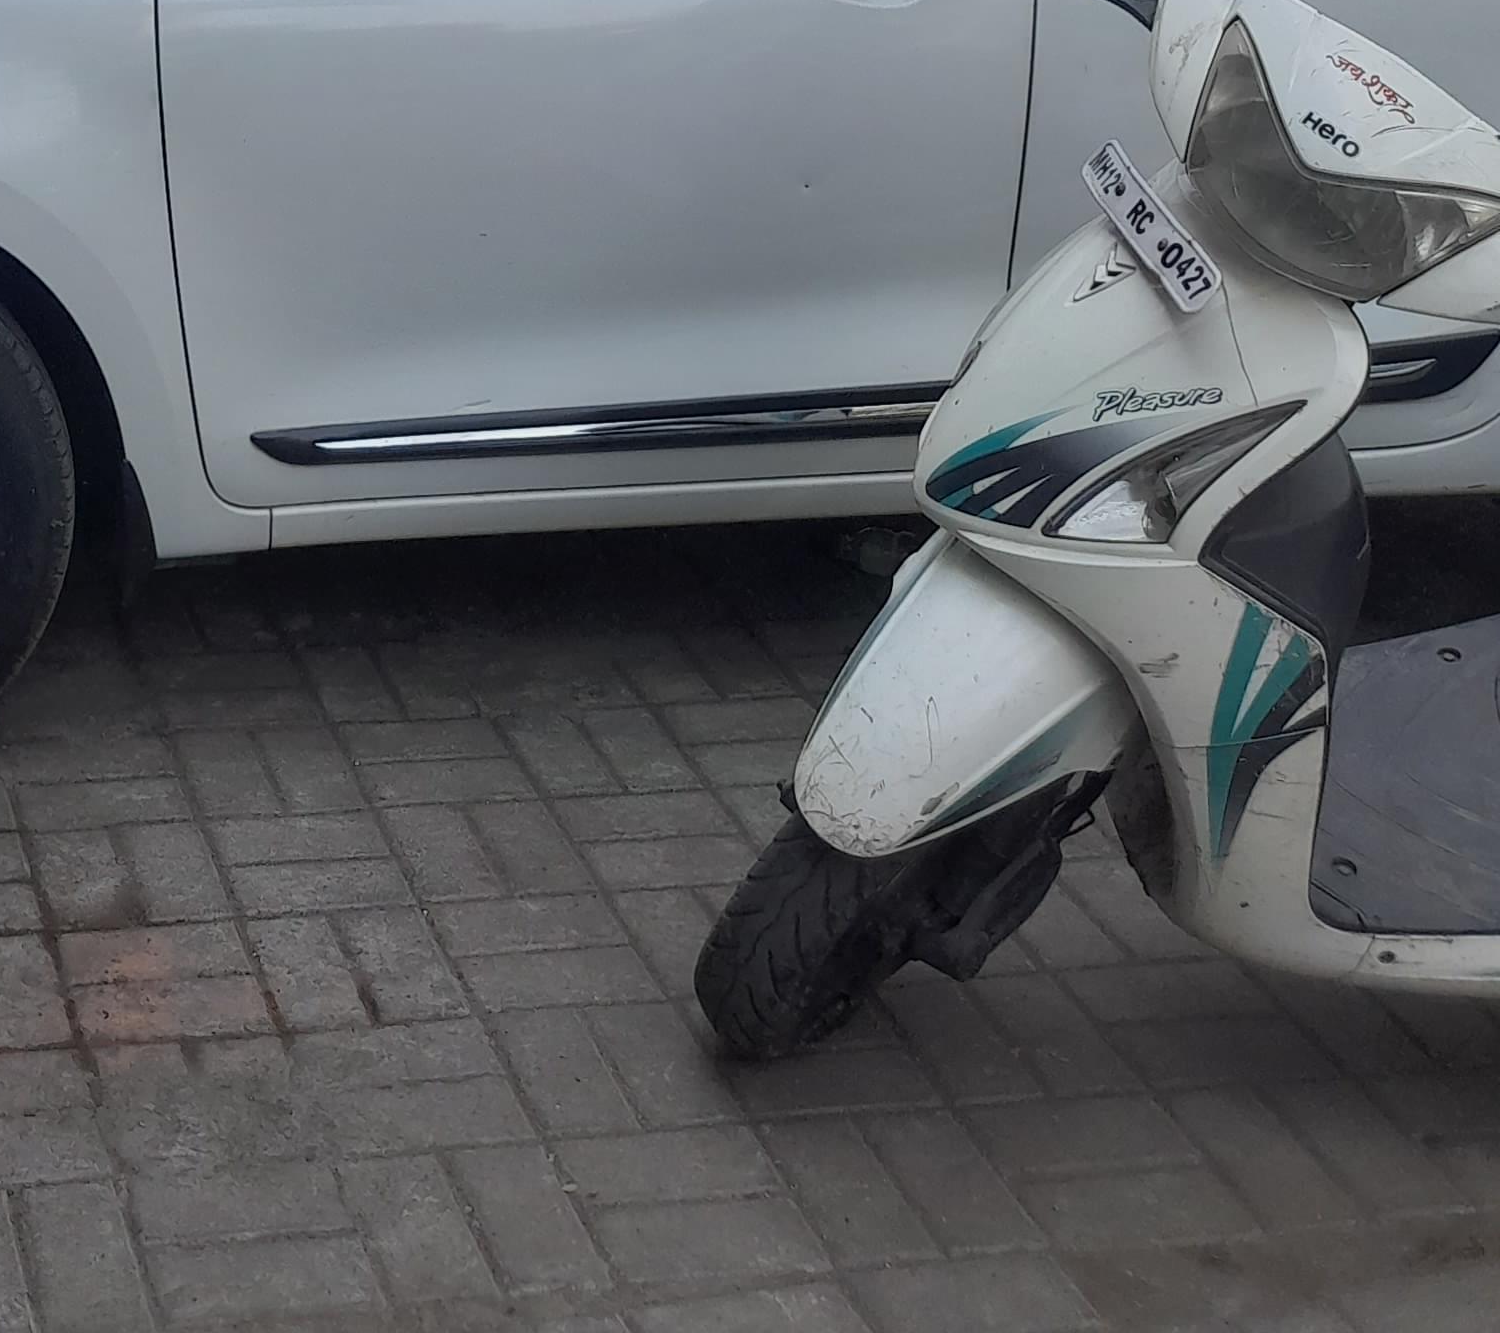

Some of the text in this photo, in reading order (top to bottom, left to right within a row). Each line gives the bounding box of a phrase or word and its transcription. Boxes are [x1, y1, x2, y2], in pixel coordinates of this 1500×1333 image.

[1325, 54, 1367, 82] जय
[1301, 111, 1360, 158] Hero
[1087, 148, 1213, 301] MH12 RC 0427
[1092, 387, 1224, 422] Pleasure
